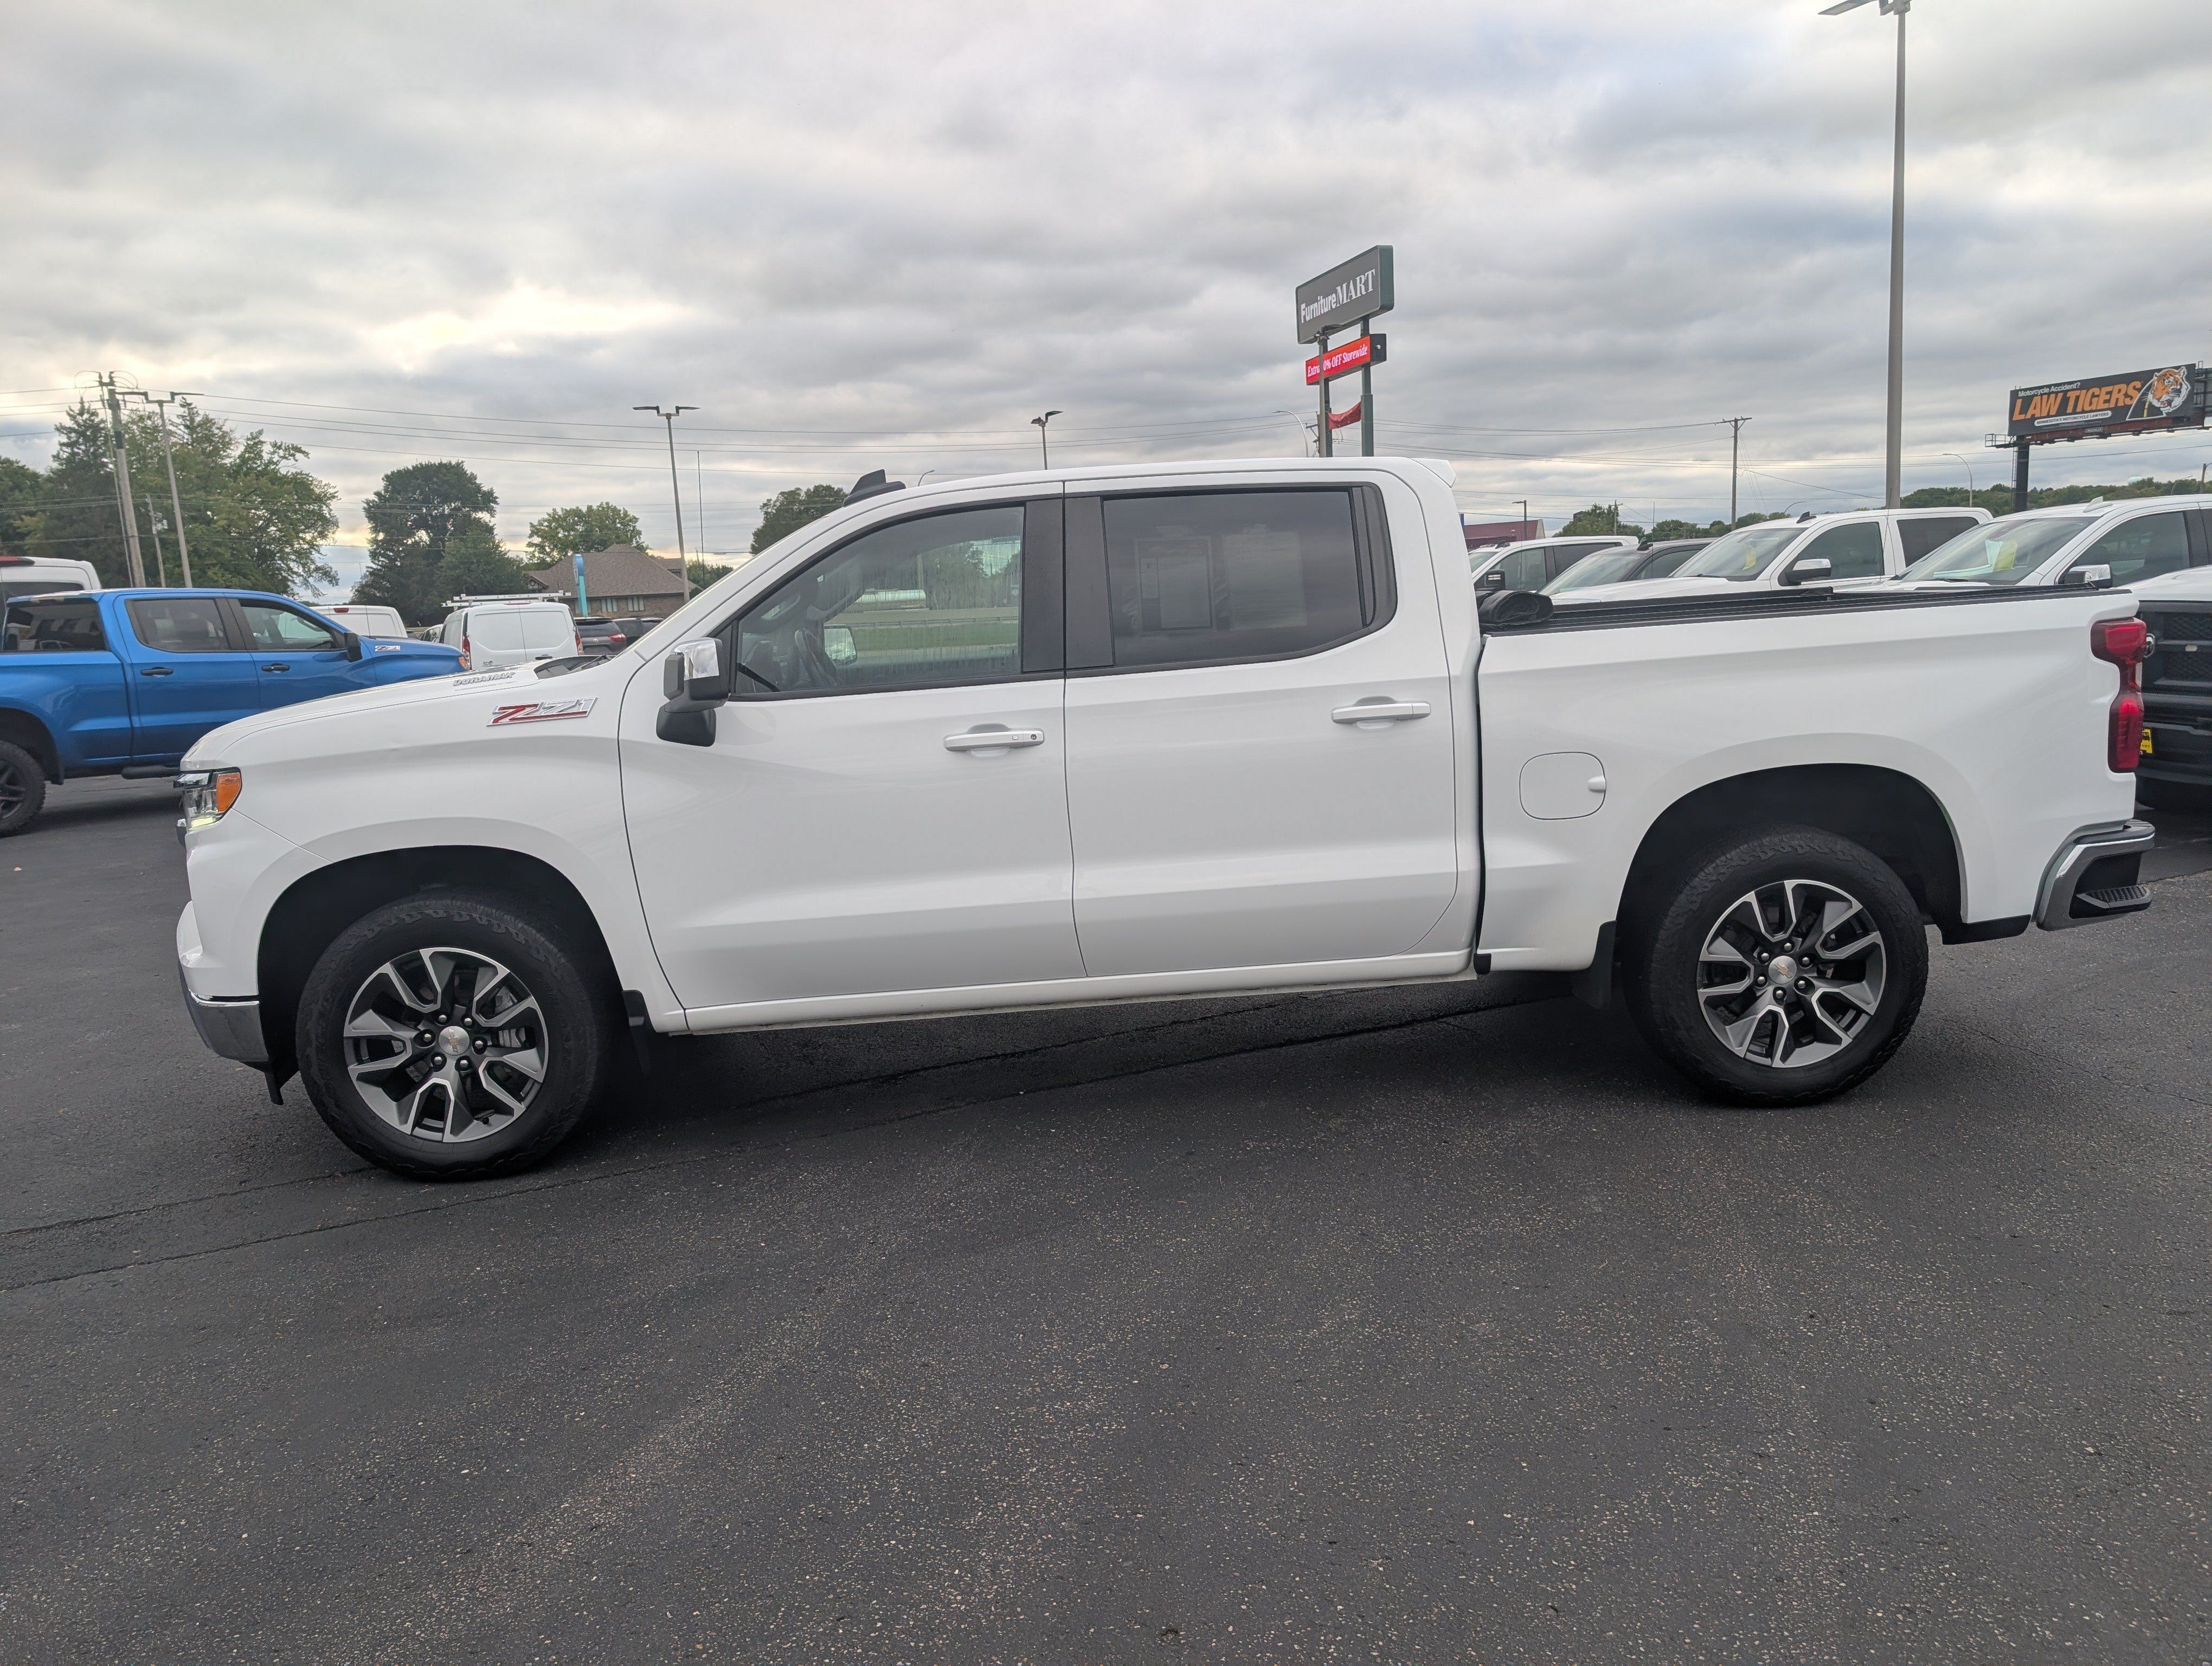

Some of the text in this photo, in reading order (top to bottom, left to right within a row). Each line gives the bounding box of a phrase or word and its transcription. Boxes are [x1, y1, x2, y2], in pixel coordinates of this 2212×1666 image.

[1300, 268, 1375, 324] FurnitureMART
[1332, 354, 1343, 368] OFF
[1342, 344, 1368, 364] Storewide
[2012, 381, 2142, 421] LAW TIGERS
[2018, 382, 2081, 398] Motorcycle Accident?
[2062, 414, 2089, 422] MOTORCYCLE
[453, 672, 516, 687] DURAMAX
[486, 697, 598, 727] Z71
